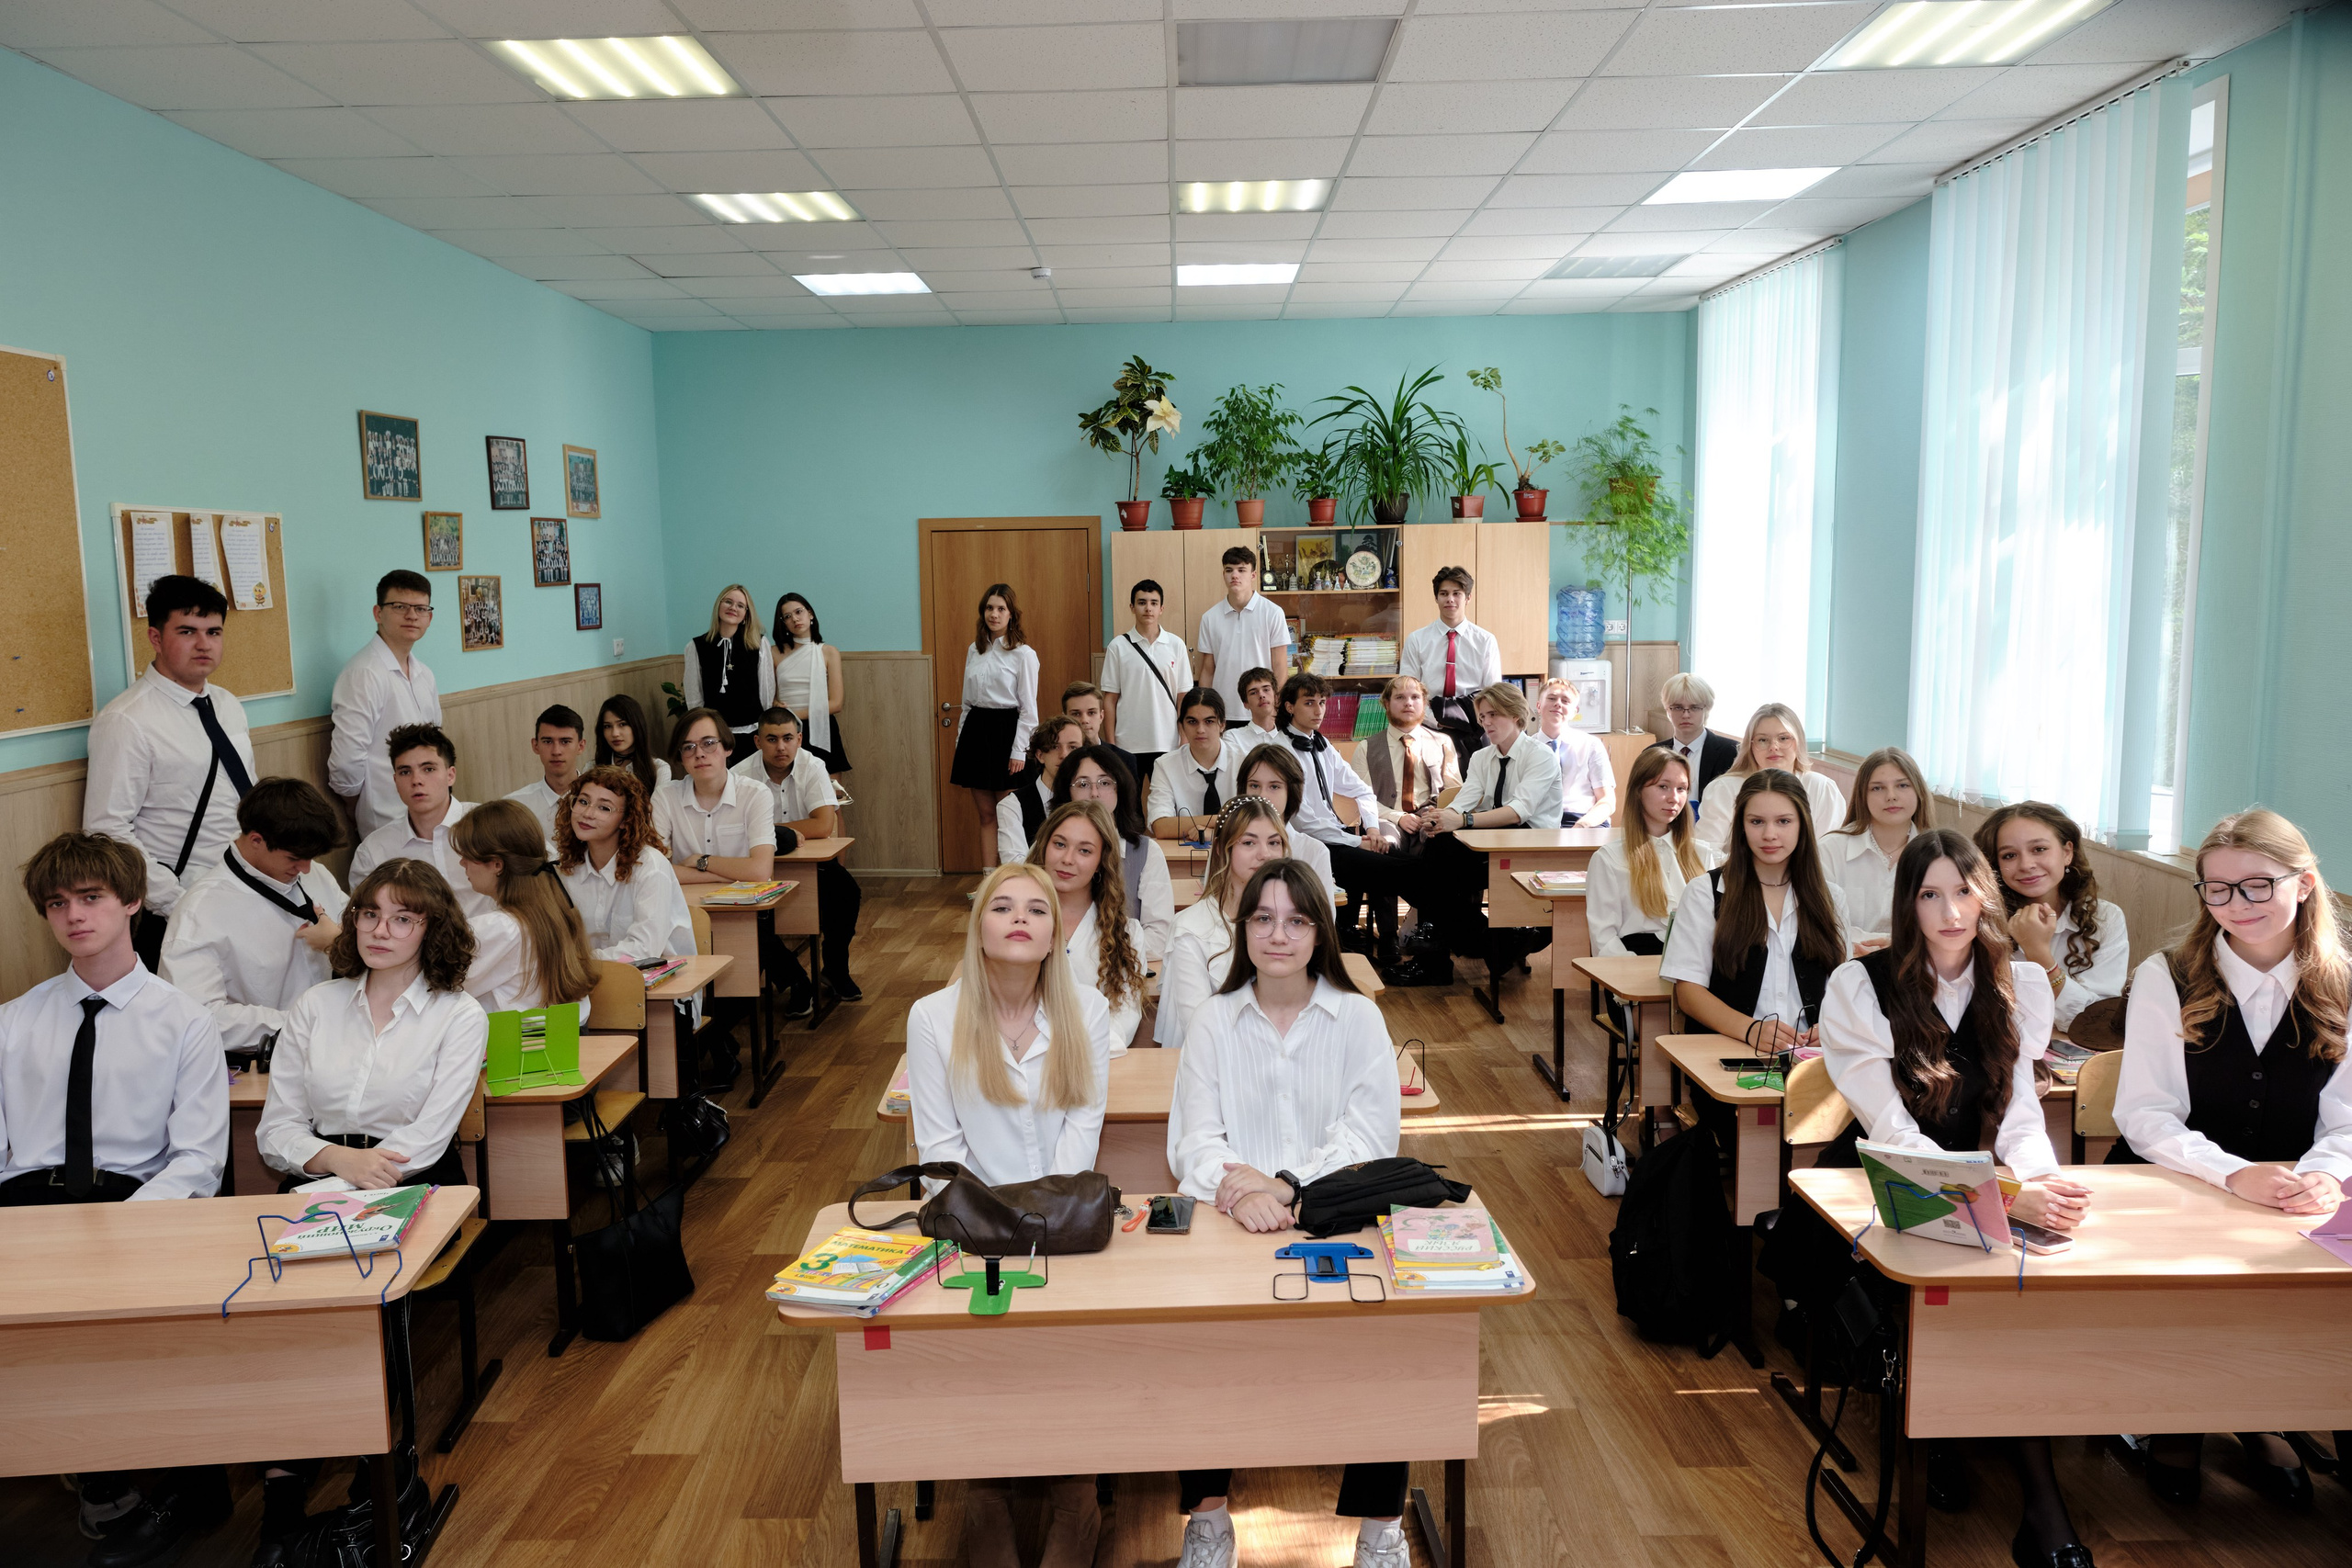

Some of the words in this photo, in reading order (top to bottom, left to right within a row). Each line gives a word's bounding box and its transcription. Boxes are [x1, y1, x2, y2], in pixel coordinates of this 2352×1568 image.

[304, 1200, 348, 1223] 3
[297, 1224, 392, 1240] Окружющий
[831, 1240, 904, 1255] МАТЕМАТИКА
[800, 1253, 840, 1271] 3
